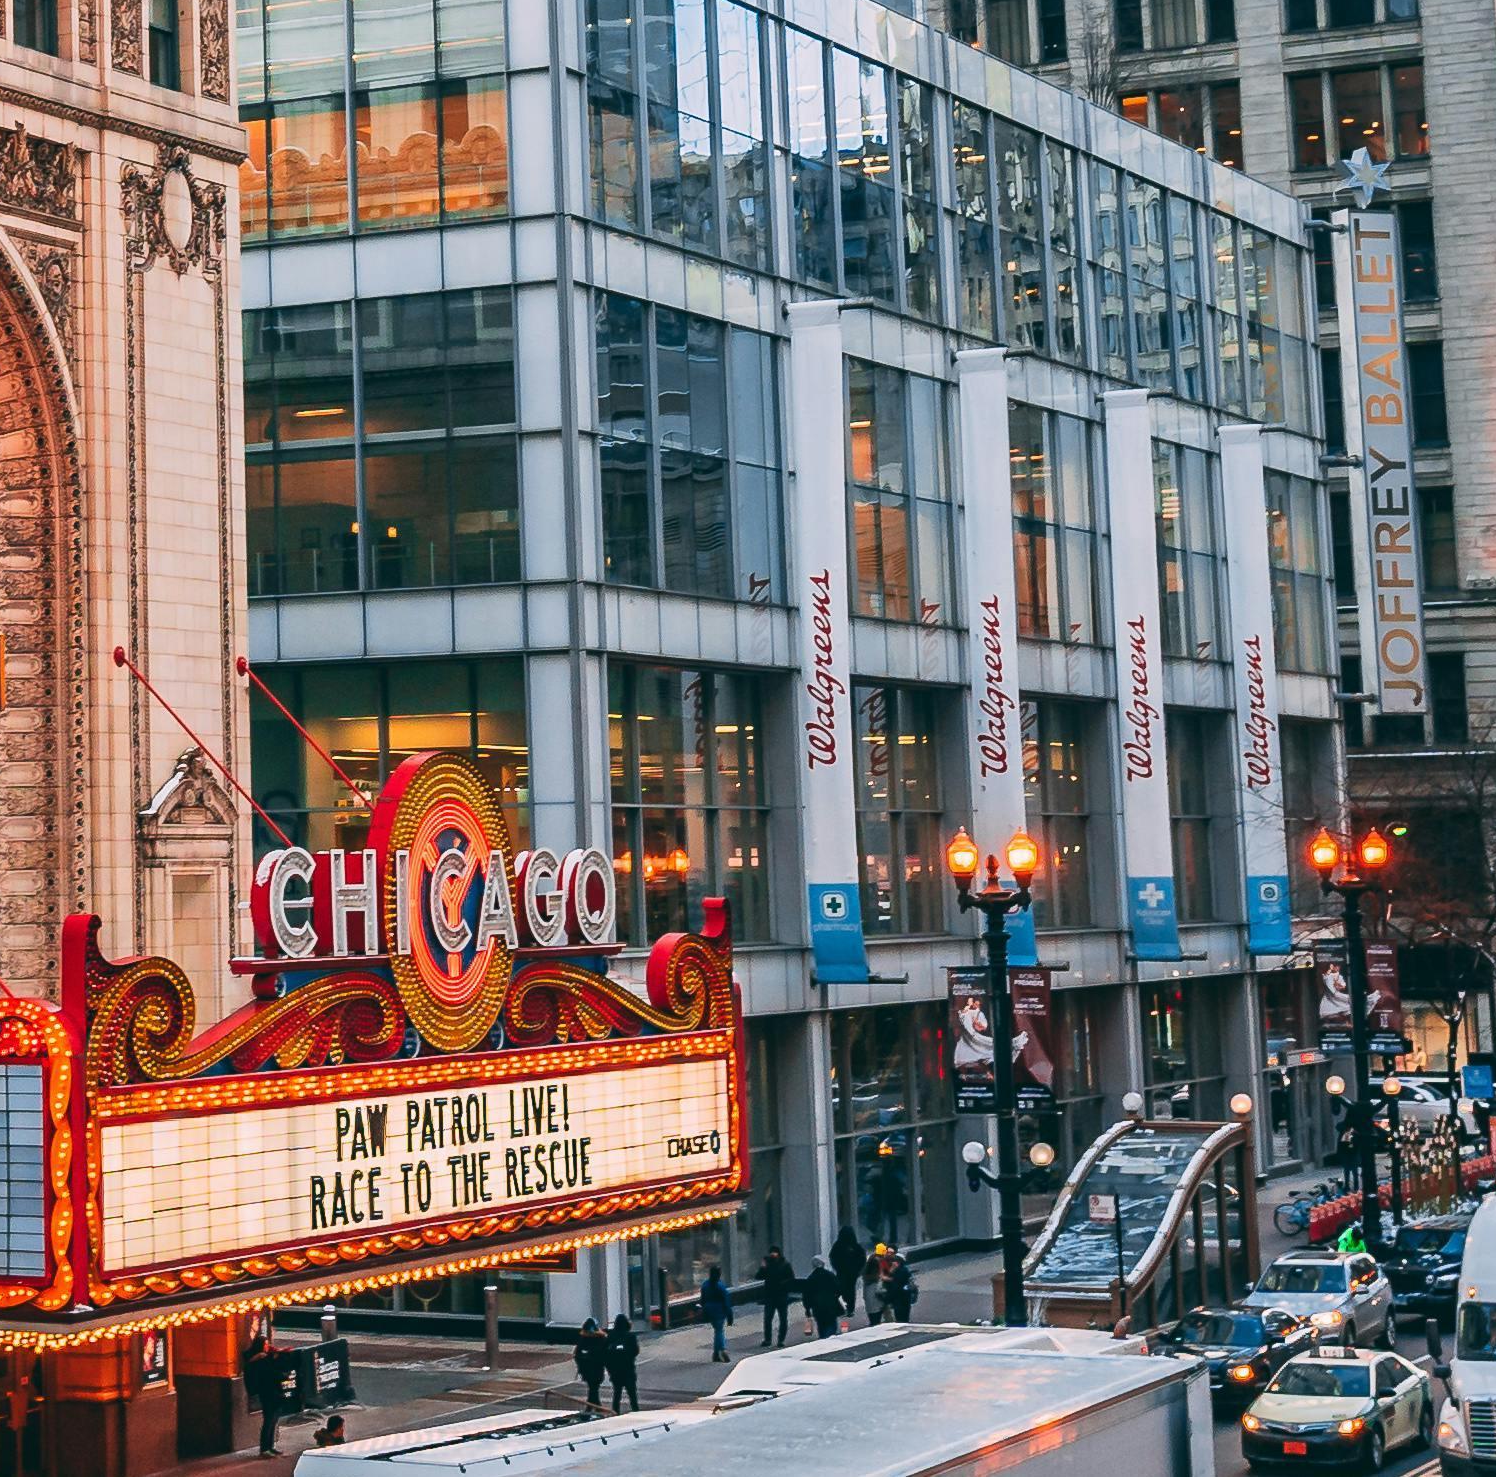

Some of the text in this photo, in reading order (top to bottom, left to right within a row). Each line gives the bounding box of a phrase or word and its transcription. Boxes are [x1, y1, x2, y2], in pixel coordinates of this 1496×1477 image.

[1353, 216, 1424, 707] JOFFREY BALLET
[805, 568, 846, 771] Walgreens
[978, 593, 1016, 778] Walgreens
[1124, 614, 1161, 785] Walgreens
[1247, 633, 1280, 791] Walgreens
[268, 845, 617, 958] CHICAGO
[310, 1137, 592, 1230] RACE TO THE RESCUE
[335, 1083, 570, 1162] PAW PATROL LIVE!
[667, 1135, 709, 1159] CHASE
